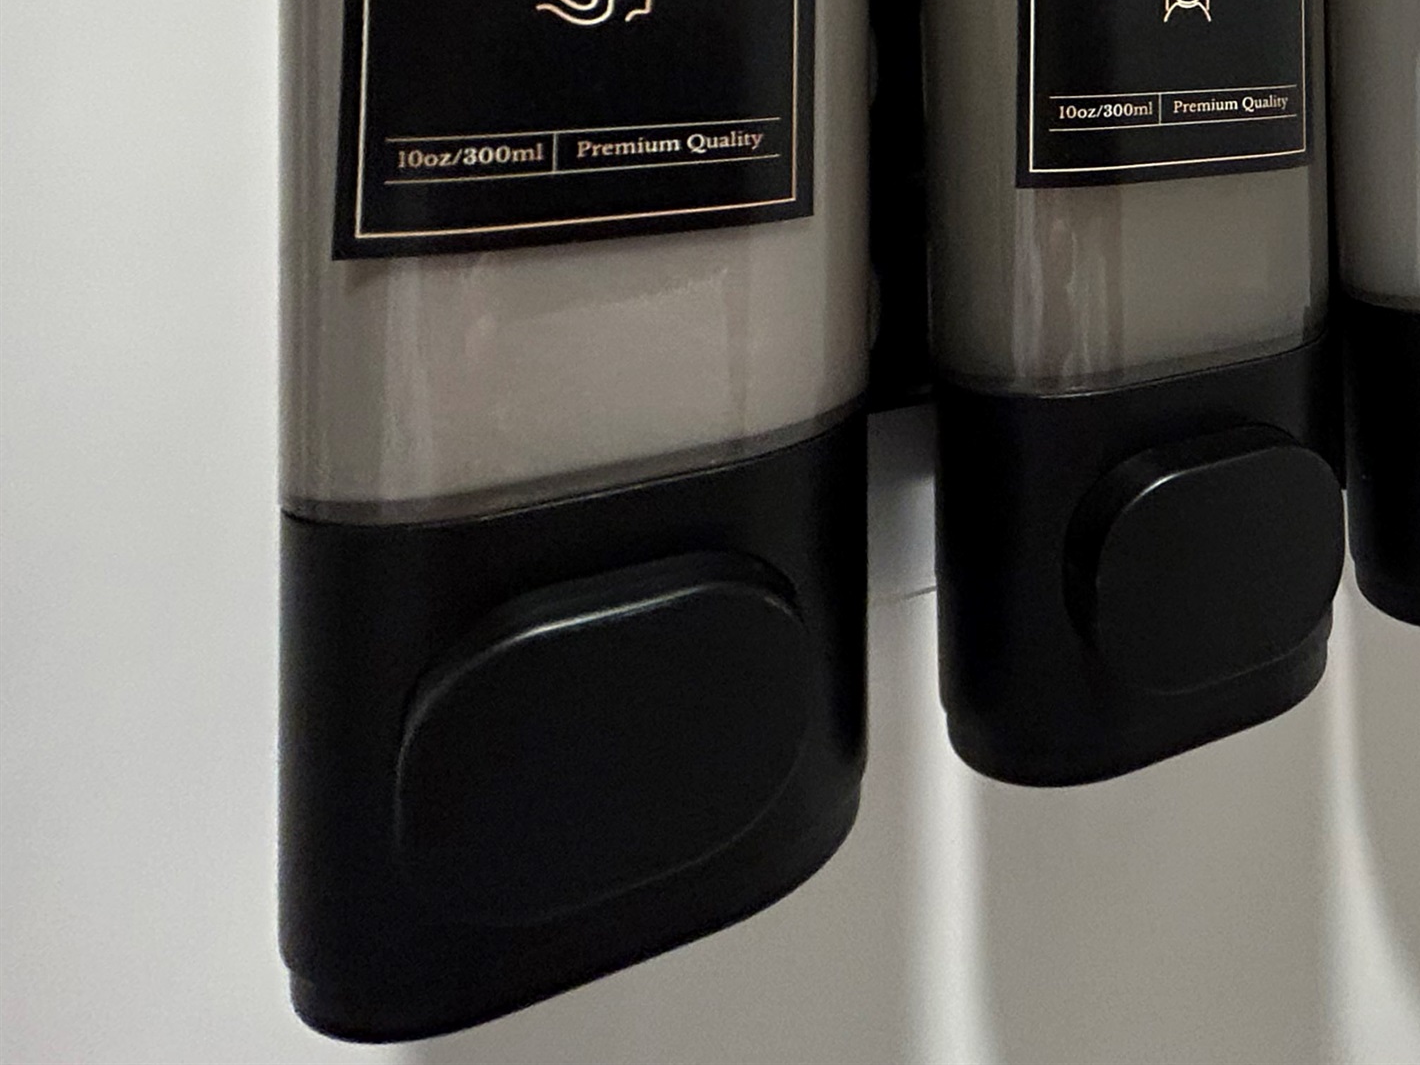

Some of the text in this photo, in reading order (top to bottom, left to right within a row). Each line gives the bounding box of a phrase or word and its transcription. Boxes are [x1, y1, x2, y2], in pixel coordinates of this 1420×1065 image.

[1058, 101, 1153, 120] 10oz/300ml
[1173, 94, 1288, 114] Premium Quality
[576, 130, 764, 157] Premium Quality
[397, 143, 543, 169] 10oz/300ml
